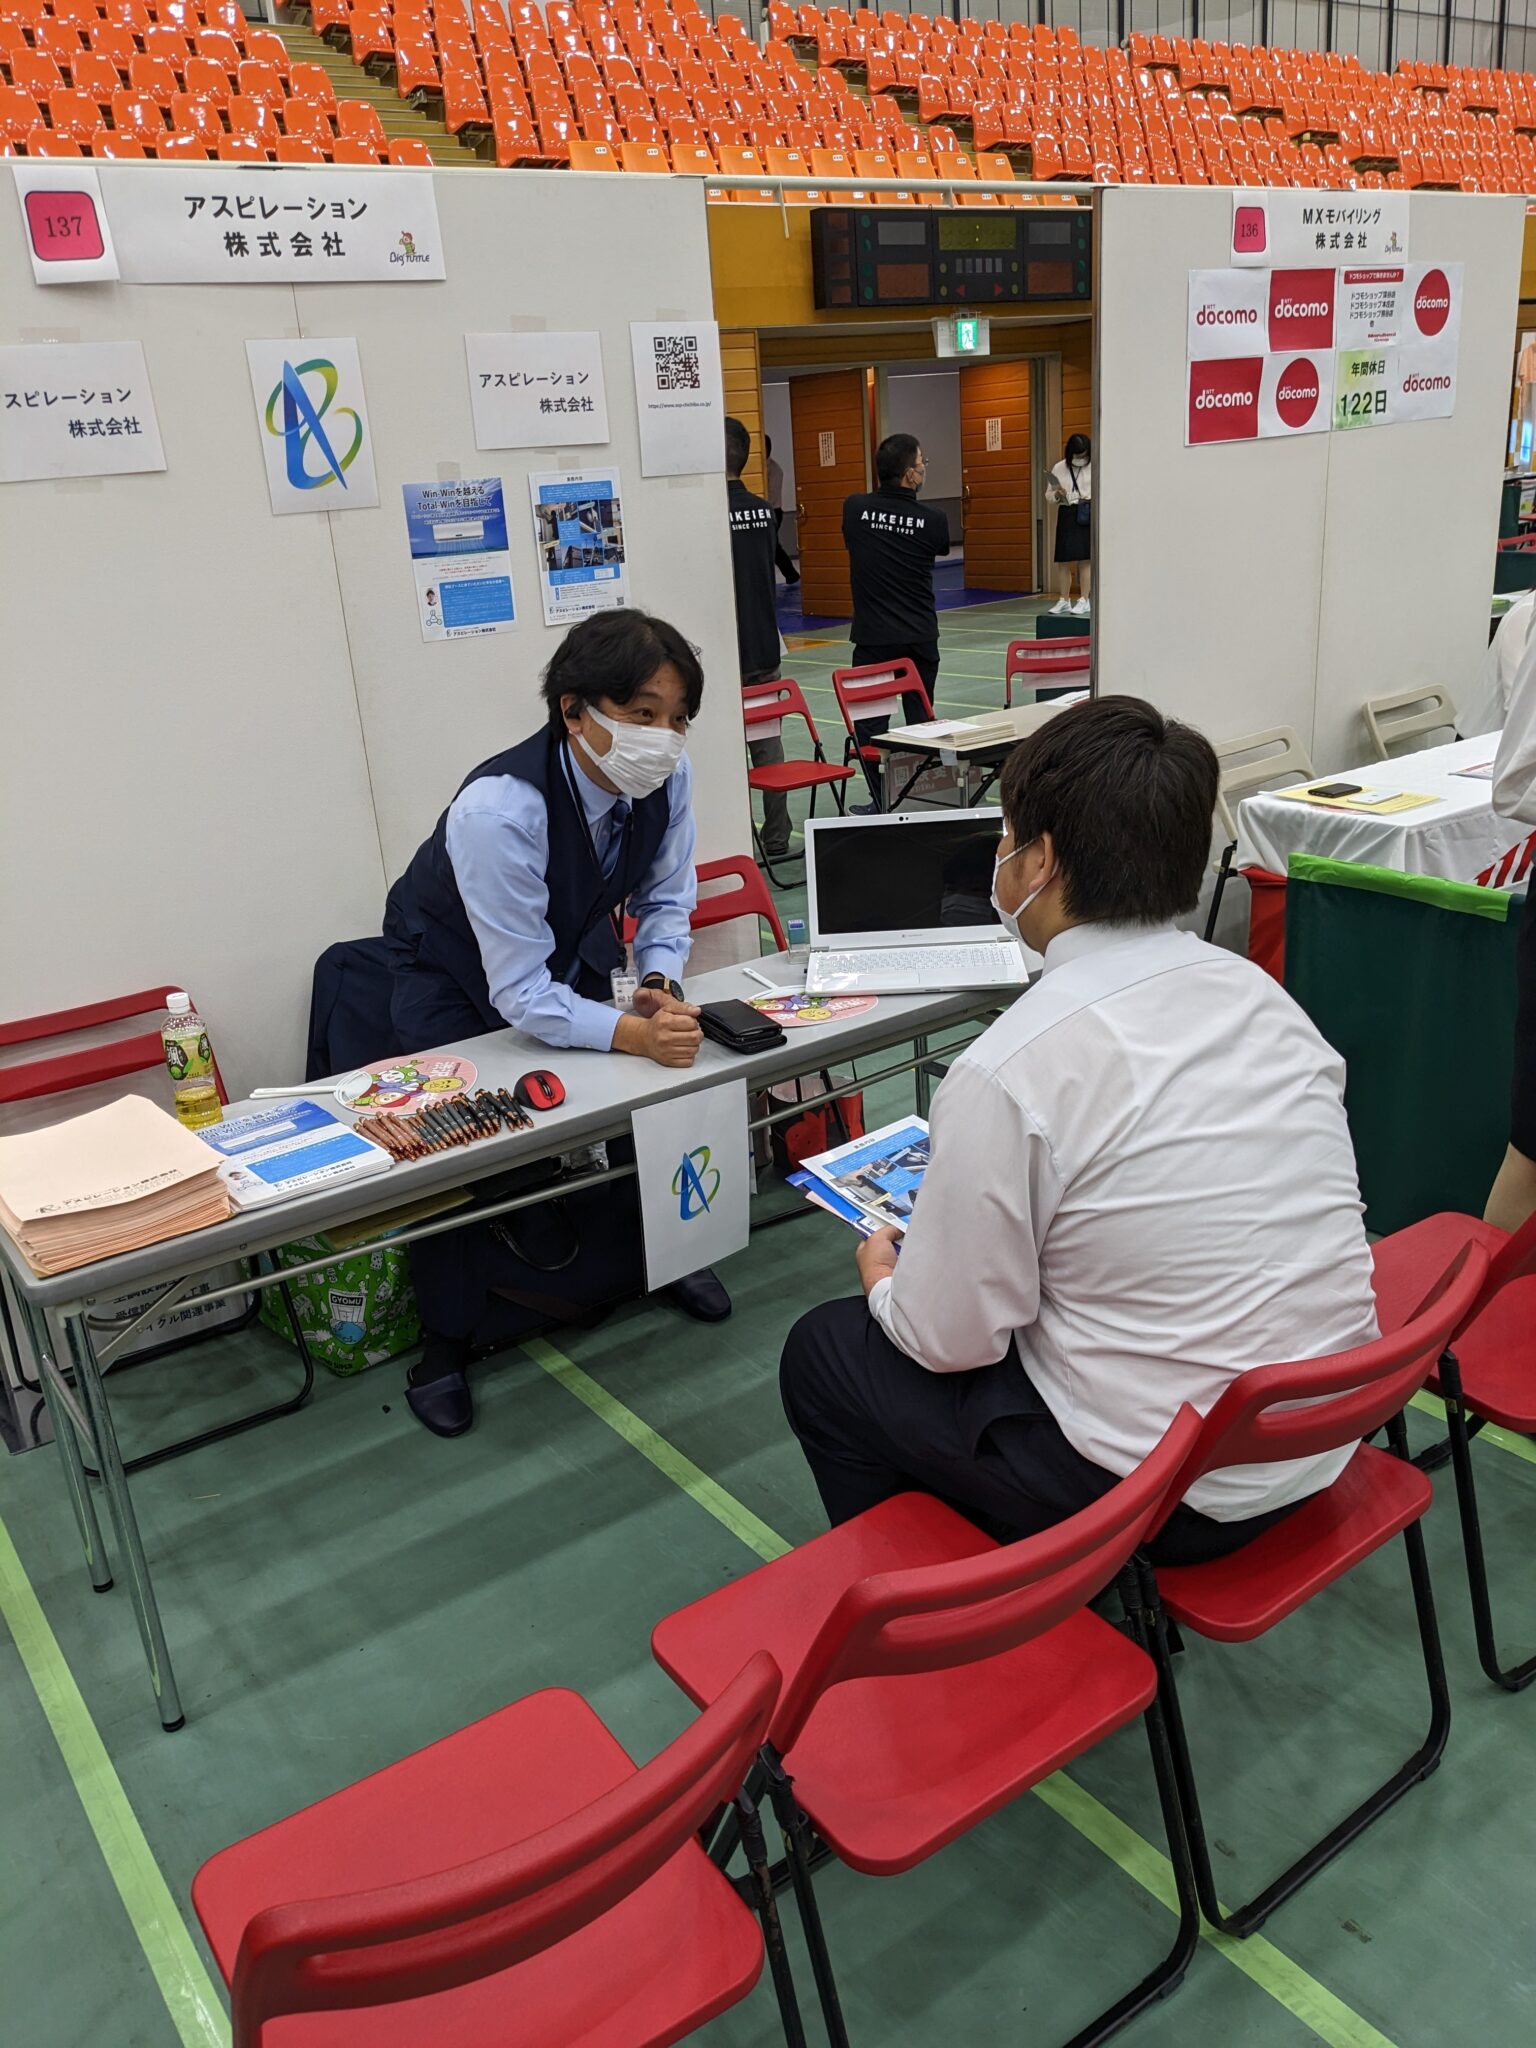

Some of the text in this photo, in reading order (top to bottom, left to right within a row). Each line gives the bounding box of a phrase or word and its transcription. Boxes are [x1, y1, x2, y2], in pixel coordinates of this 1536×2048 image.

[183, 195, 368, 220] アスピレーション
[45, 215, 83, 238] 137
[1240, 223, 1259, 238] 136
[223, 231, 346, 258] 株式会社
[1315, 231, 1368, 250] 株式会社
[1274, 299, 1329, 319] docomo
[1416, 297, 1449, 309] docomo
[1196, 305, 1258, 326] docomo
[1351, 360, 1386, 377] 年間休日
[479, 371, 590, 388] アスピレーション
[1402, 374, 1451, 393] docomo
[0, 388, 132, 409] スピレーション
[1195, 390, 1253, 410] docomo
[1278, 387, 1317, 400] docomo
[539, 396, 595, 414] 株式会社
[1340, 390, 1387, 417] 122日
[68, 416, 143, 439] 株式会社
[732, 523, 750, 531] SINCE
[860, 510, 925, 529] AIKEIEN
[871, 522, 893, 531] SINCE
[331, 1295, 362, 1305] GYOMU
